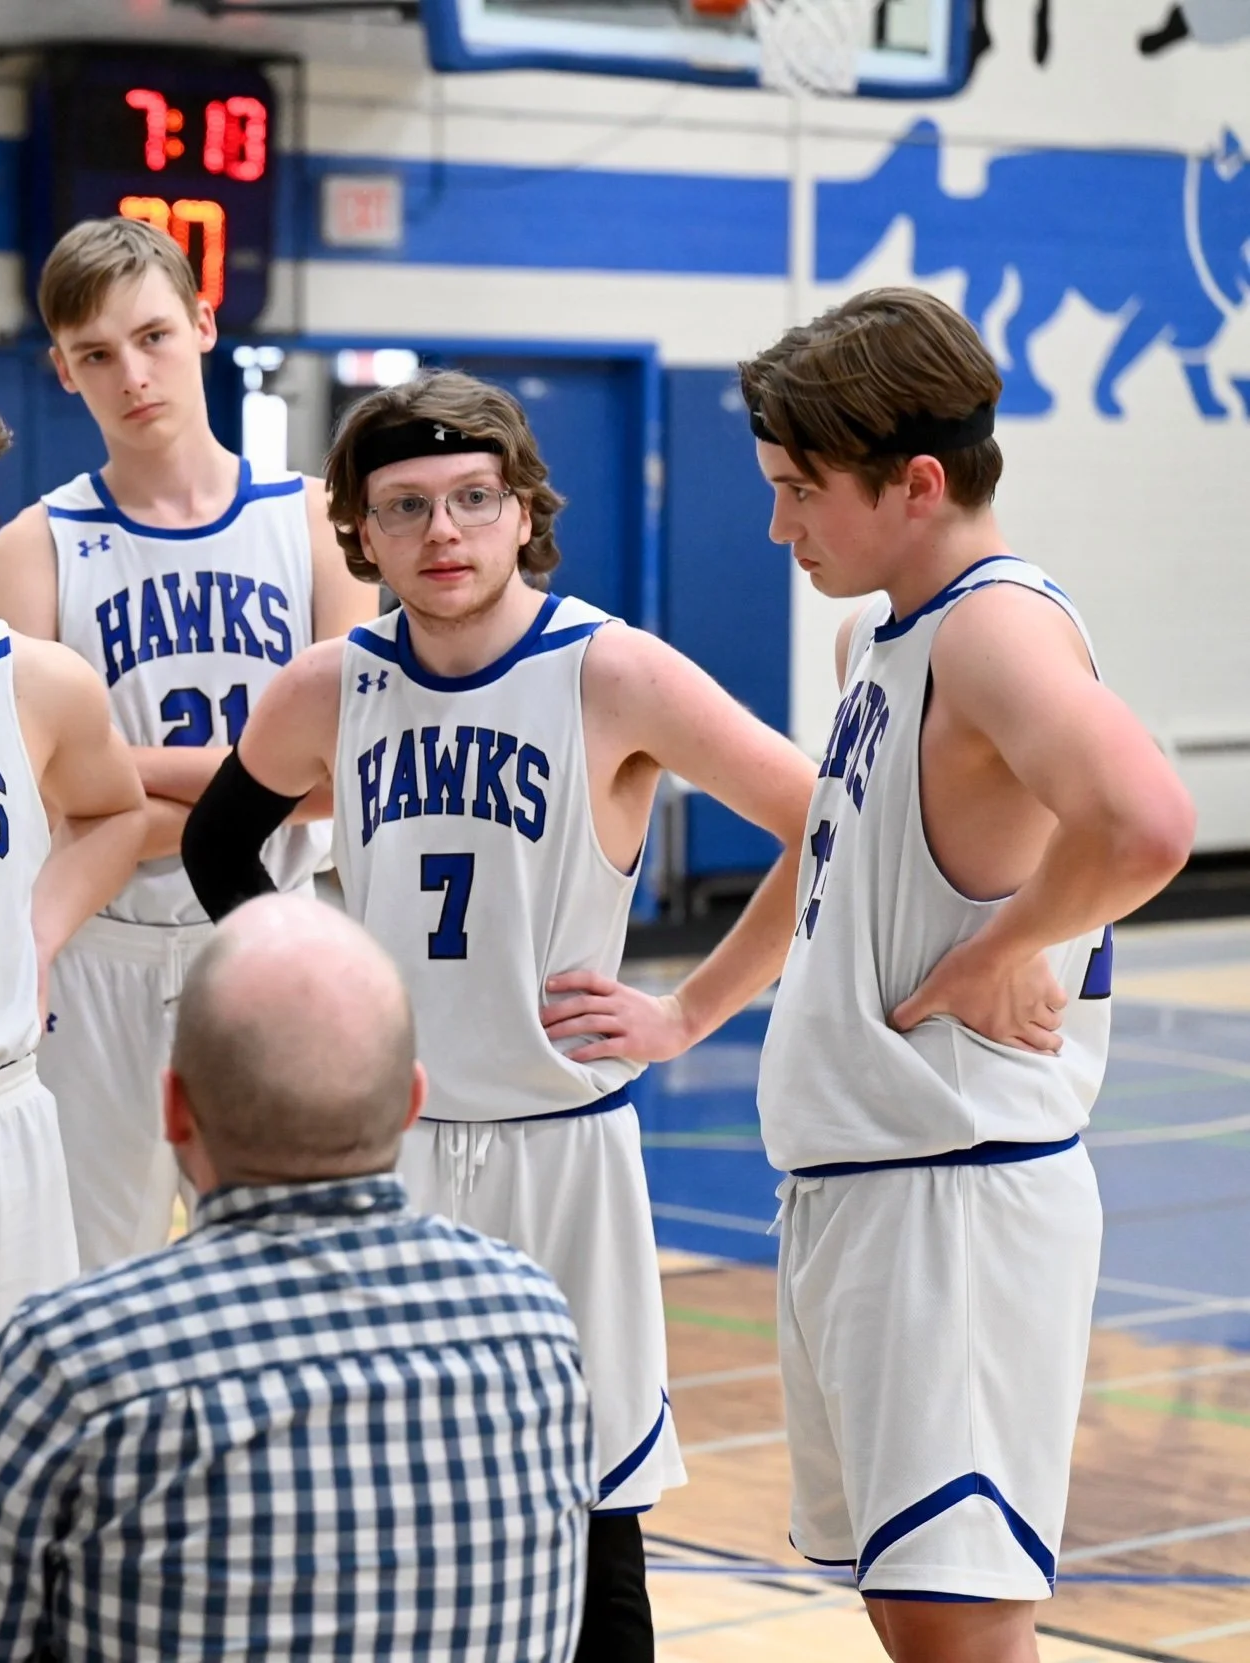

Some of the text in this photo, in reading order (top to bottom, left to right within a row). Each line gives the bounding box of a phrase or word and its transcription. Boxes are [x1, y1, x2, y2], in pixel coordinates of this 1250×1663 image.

[96, 571, 293, 688] HAWKS
[160, 684, 249, 747] 21
[357, 726, 550, 848] HAWKS
[420, 853, 475, 960] 7
